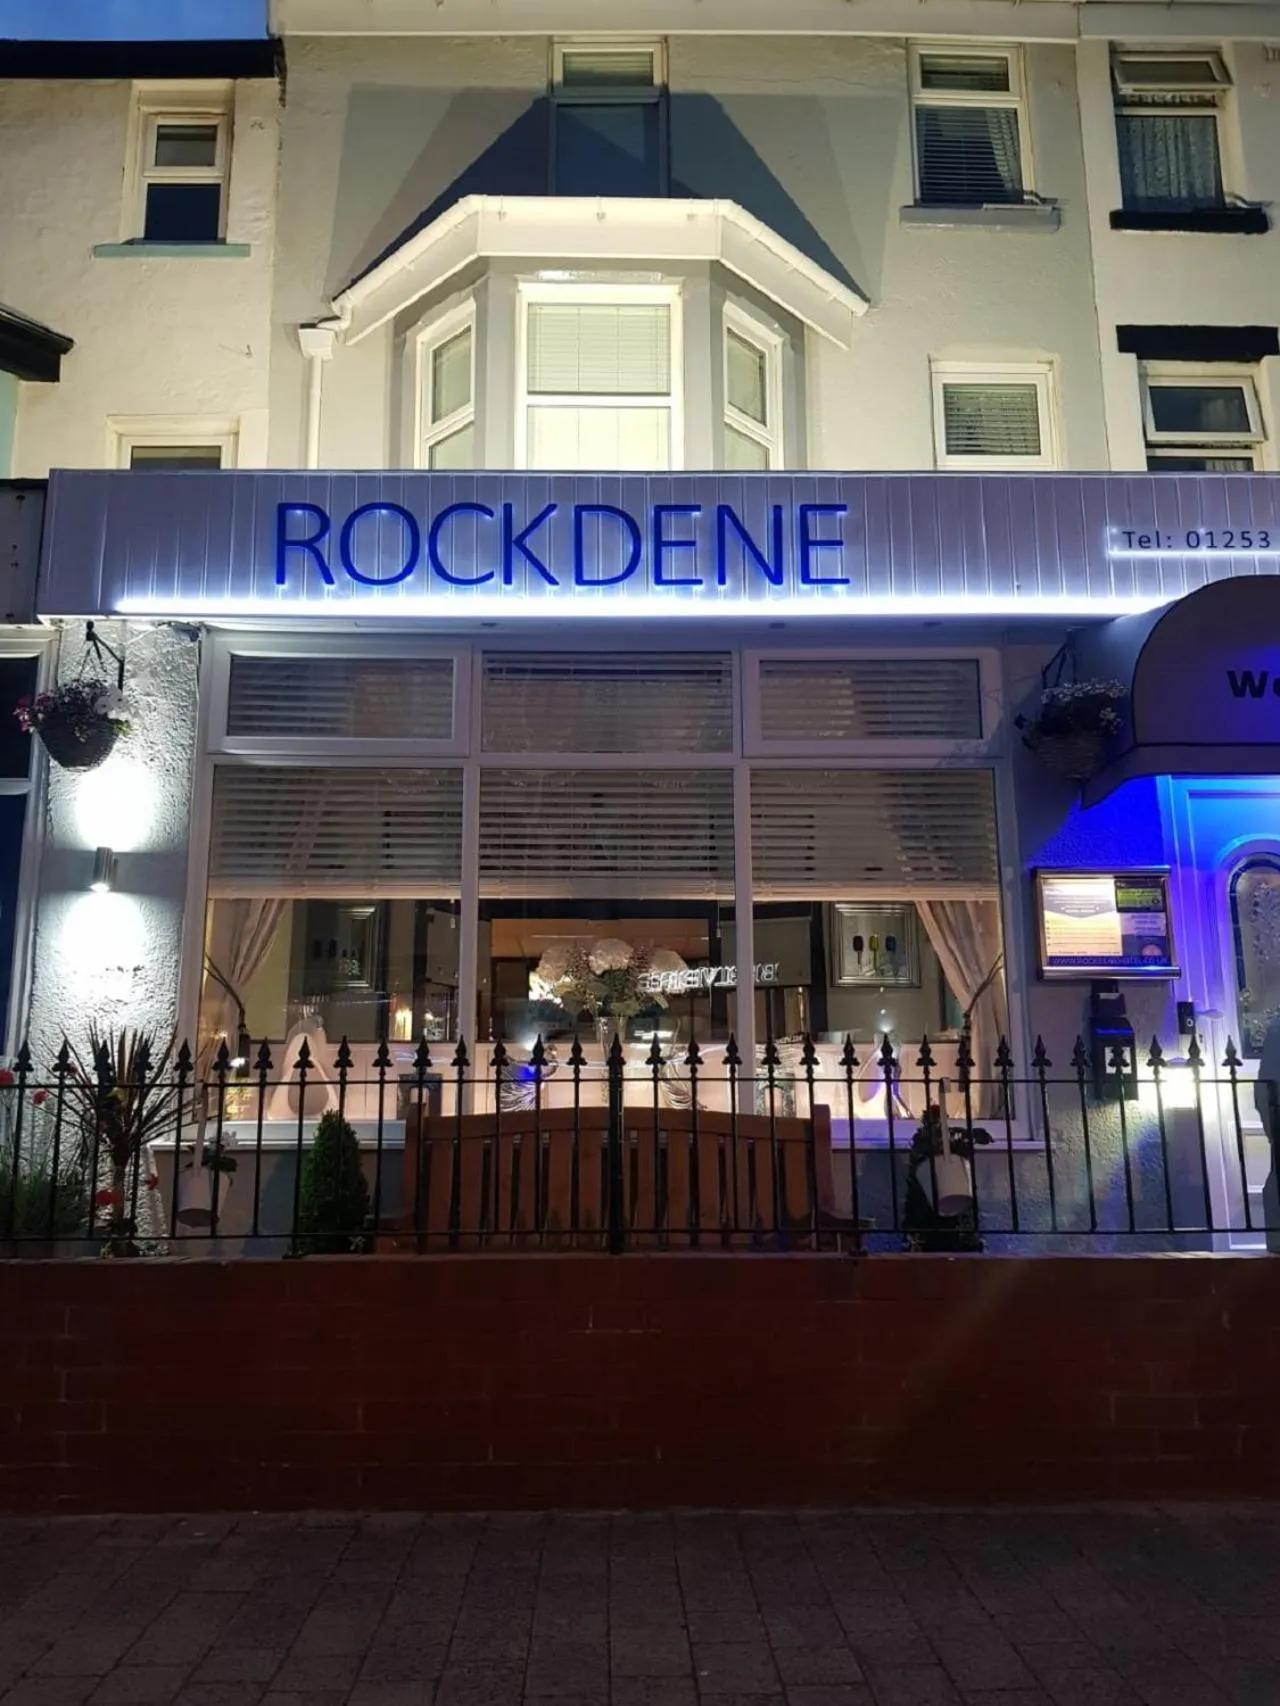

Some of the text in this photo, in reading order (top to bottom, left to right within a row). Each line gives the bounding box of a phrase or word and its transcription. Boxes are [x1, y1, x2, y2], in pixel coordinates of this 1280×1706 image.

[275, 501, 849, 586] ROCKDENE
[1122, 530, 1271, 549] Tel: 01253
[1226, 670, 1280, 698] W
